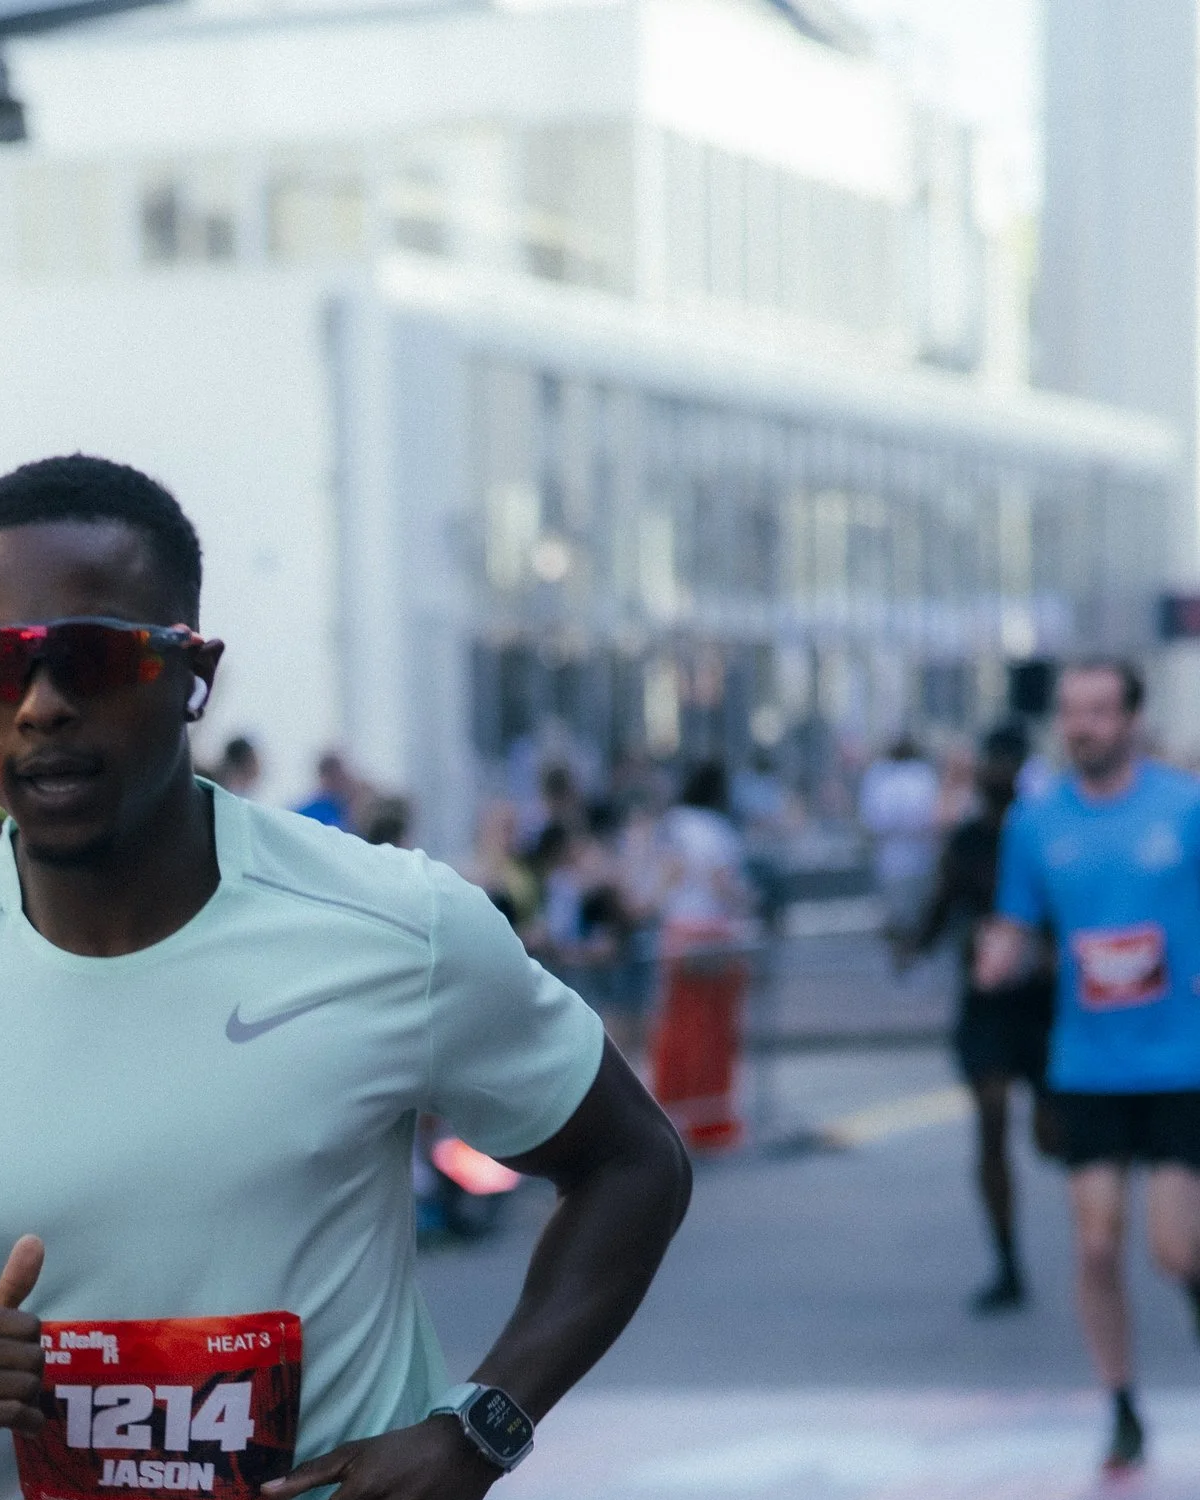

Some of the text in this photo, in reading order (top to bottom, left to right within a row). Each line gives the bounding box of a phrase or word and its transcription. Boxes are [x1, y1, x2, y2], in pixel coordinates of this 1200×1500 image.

[207, 1331, 271, 1353] HEAT 3
[54, 1381, 255, 1452] 1214
[98, 1459, 215, 1491] JASON
